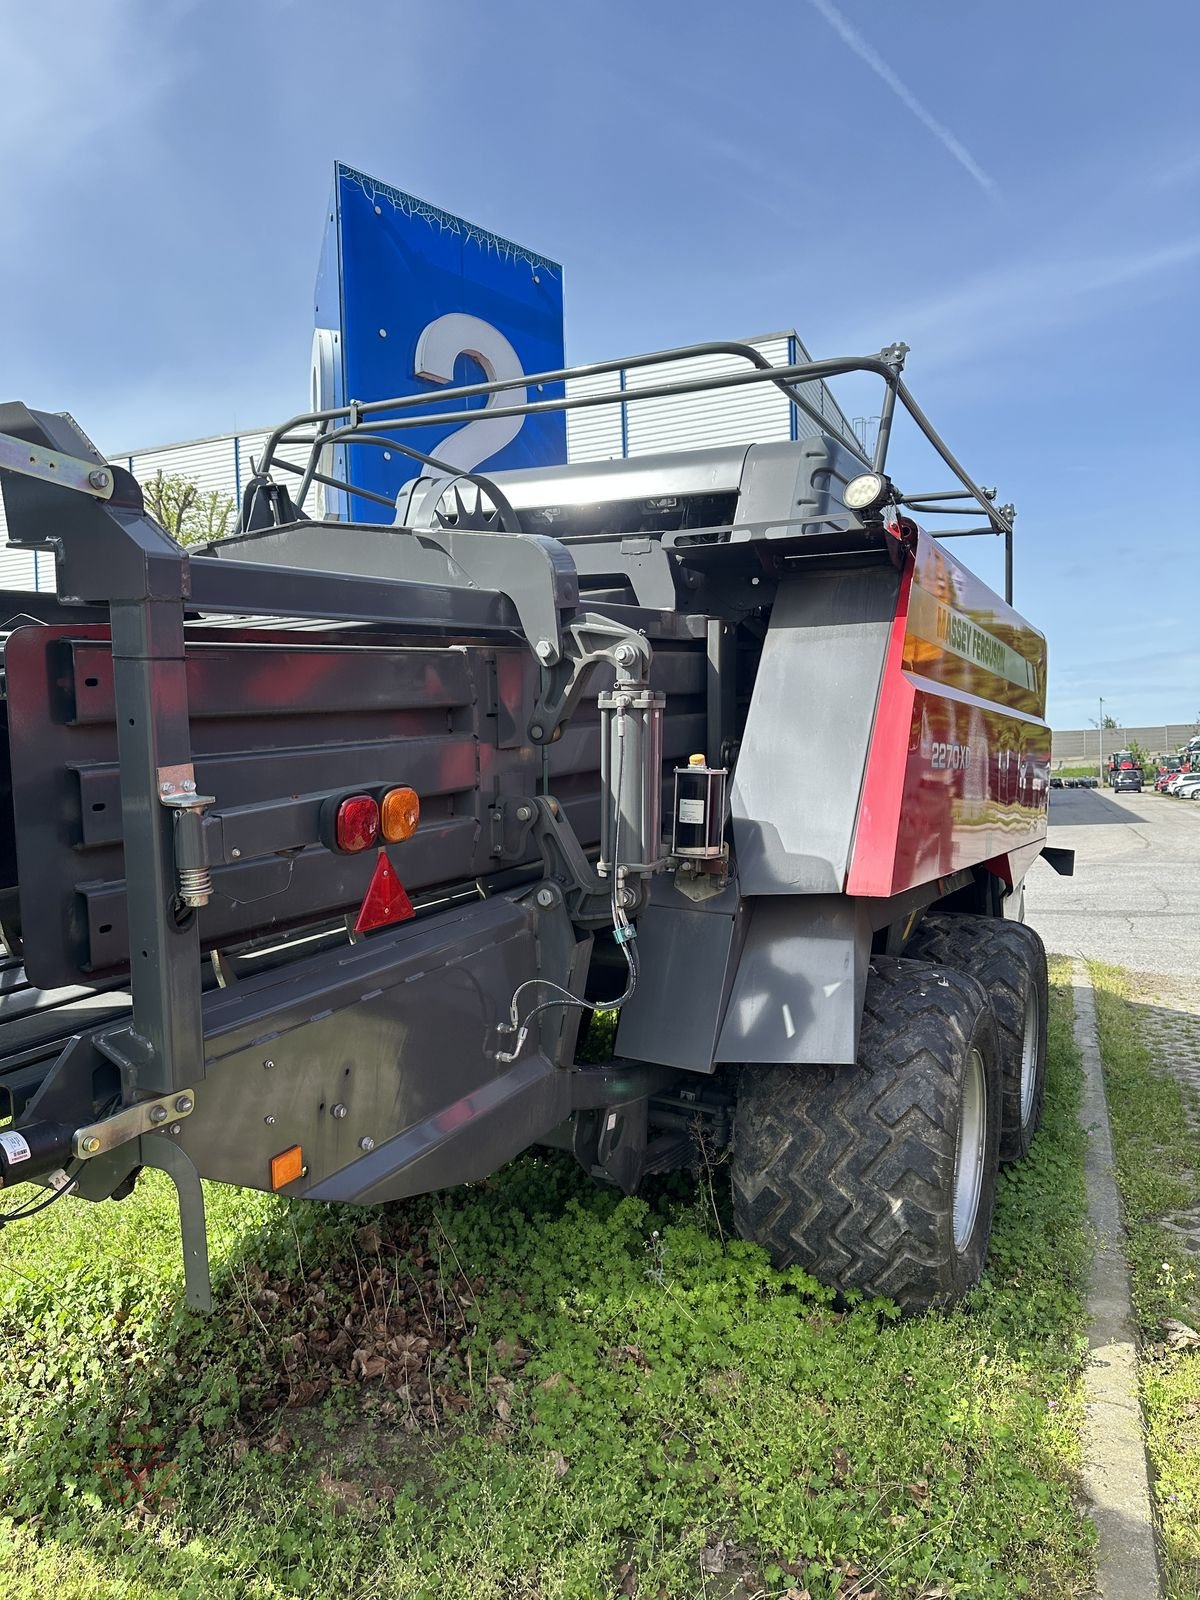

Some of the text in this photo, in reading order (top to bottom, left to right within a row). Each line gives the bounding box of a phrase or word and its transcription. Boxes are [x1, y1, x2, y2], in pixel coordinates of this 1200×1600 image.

[415, 313, 527, 478] 2
[936, 606, 1006, 674] MASSEY FERGUSON
